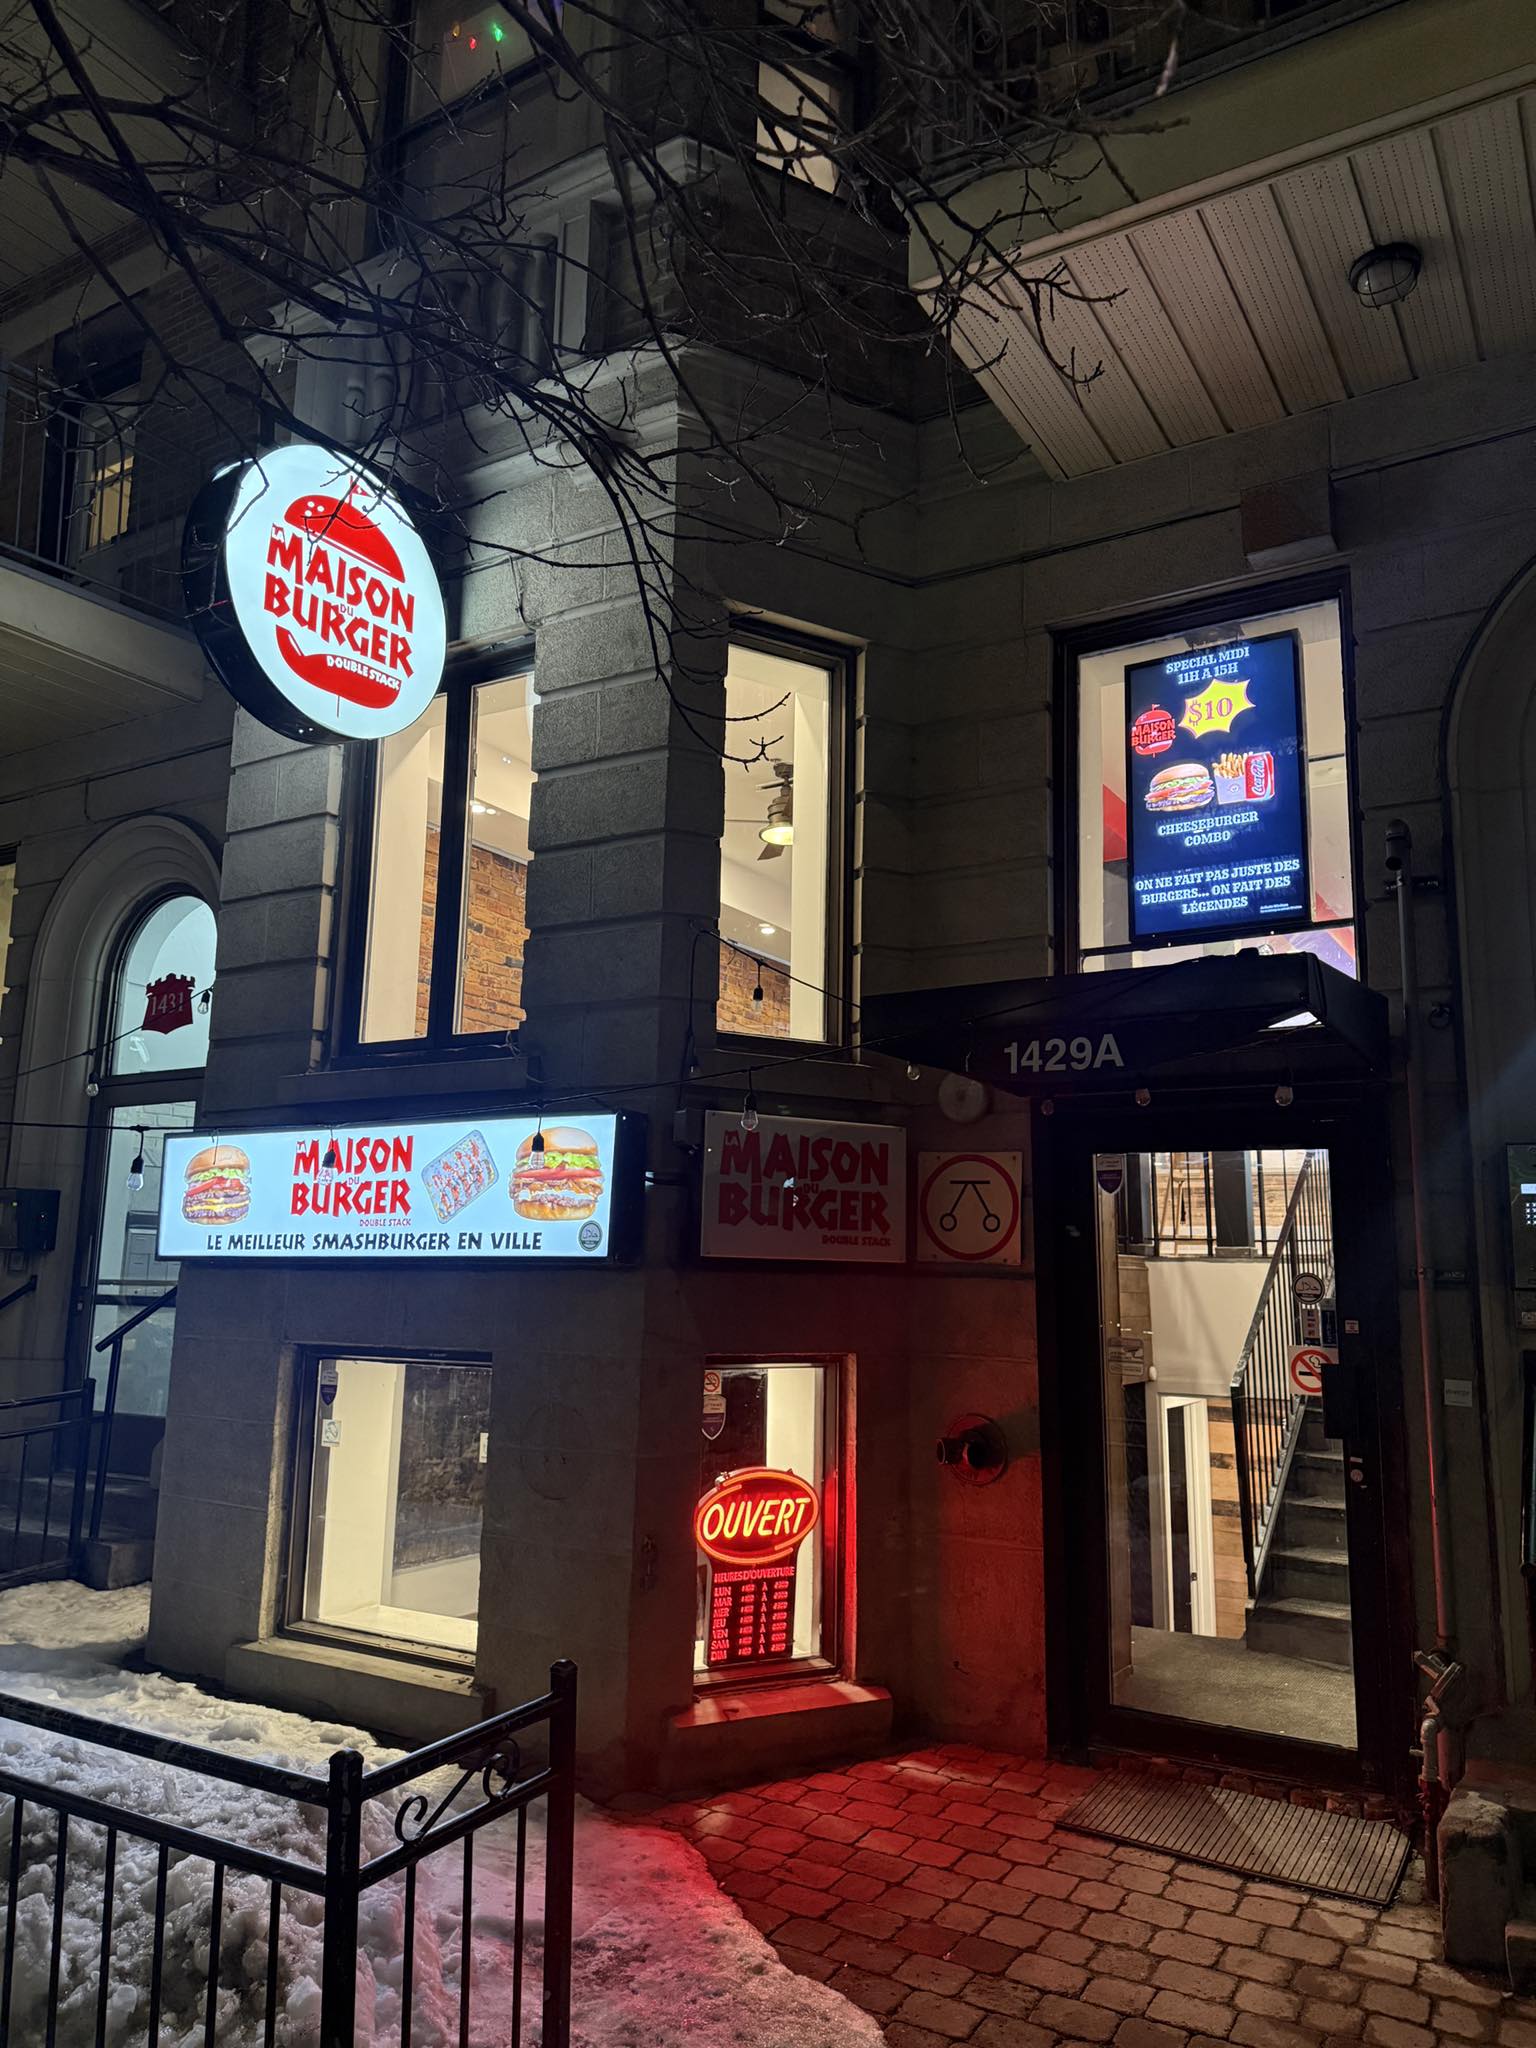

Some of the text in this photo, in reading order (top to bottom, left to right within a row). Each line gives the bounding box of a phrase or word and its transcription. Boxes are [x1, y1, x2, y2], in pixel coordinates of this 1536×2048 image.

[272, 526, 285, 542] LA
[267, 524, 415, 633] MAISON
[340, 603, 354, 617] DU
[264, 572, 414, 678] BURGER
[1166, 646, 1250, 674] SPECIAL MIDI
[326, 655, 401, 691] DOUBLE STACK
[1178, 670, 1200, 684] 11H
[1213, 662, 1239, 677] 15H
[1188, 697, 1233, 727] $10
[1132, 719, 1175, 737] MAISON
[1132, 730, 1176, 746] BURGER
[1158, 811, 1259, 836] CHEESEBURGER
[1184, 830, 1231, 847] COMBO
[1135, 859, 1300, 891] ON NE FAIT PAS JUSTE DES
[1141, 875, 1291, 905] BURGERS... ON FAIT DES
[1182, 896, 1248, 915] LÉGENDES
[152, 992, 184, 1016] 1431
[1004, 1033, 1125, 1074] 1429A
[725, 1136, 739, 1147] LA
[293, 1136, 413, 1181] MAISON
[720, 1130, 888, 1186] MAISON
[348, 1177, 360, 1185] DU
[803, 1183, 819, 1194] DU
[291, 1178, 411, 1217] BURGER
[718, 1182, 891, 1235] BURGER
[360, 1218, 411, 1227] DOUBLE STACK
[207, 1232, 543, 1250] LE MEILLEUR SMASHBURGER EN VILLE
[822, 1235, 891, 1247] DOUBLE STACK
[702, 1498, 811, 1541] OUVERT
[714, 1566, 795, 1583] HEURES D'OUVERTURE
[714, 1586, 732, 1597] LUN
[711, 1639, 730, 1650] SAM
